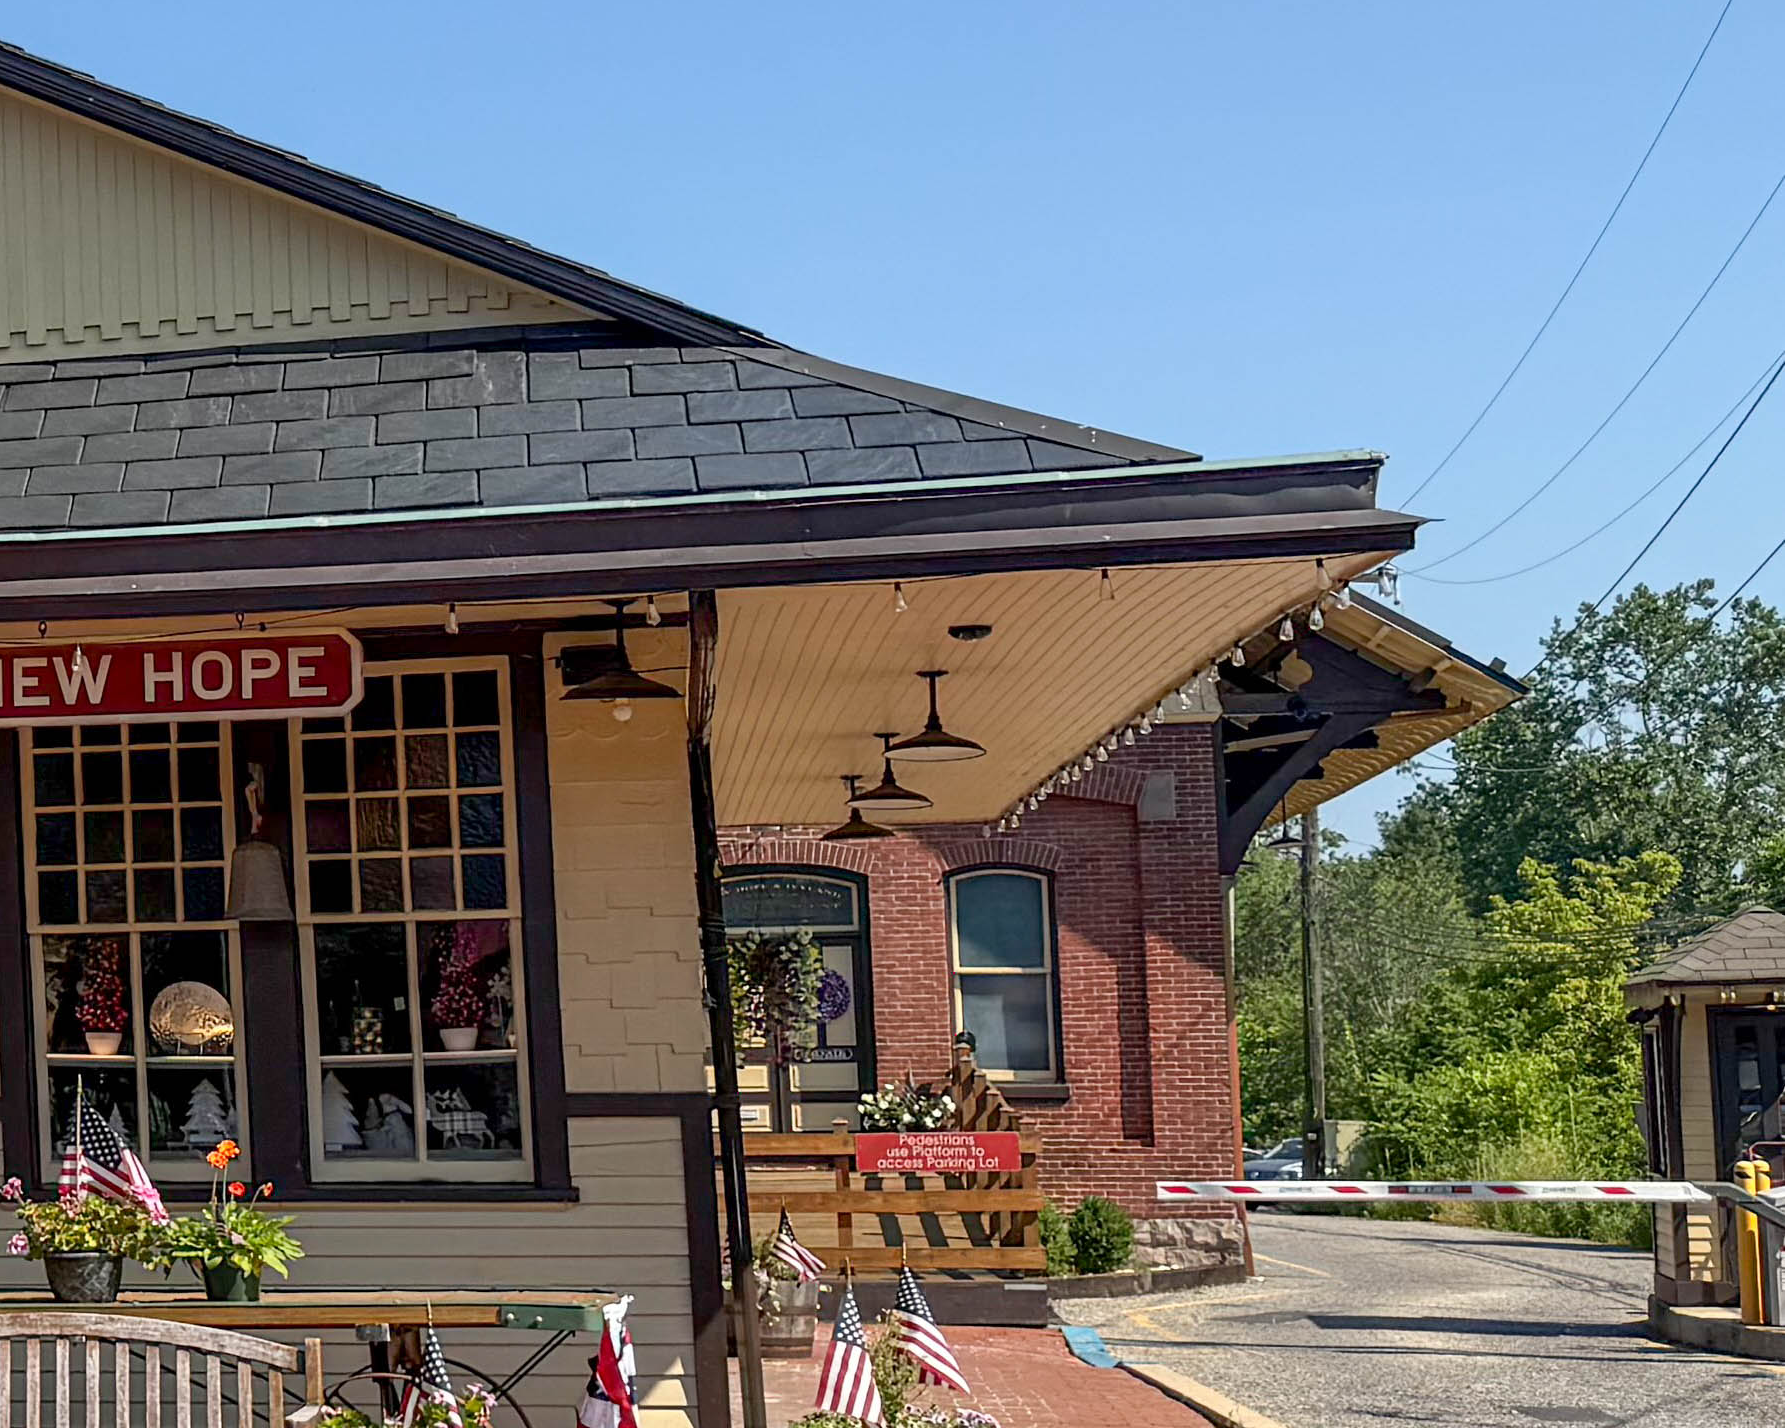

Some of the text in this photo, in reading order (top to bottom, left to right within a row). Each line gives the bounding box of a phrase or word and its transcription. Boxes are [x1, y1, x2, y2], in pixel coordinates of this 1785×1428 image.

[143, 646, 329, 704] HOPE
[899, 1134, 975, 1146] Pedestrians
[886, 1145, 985, 1157] use Platform to
[877, 1156, 999, 1171] access Parking Lot
